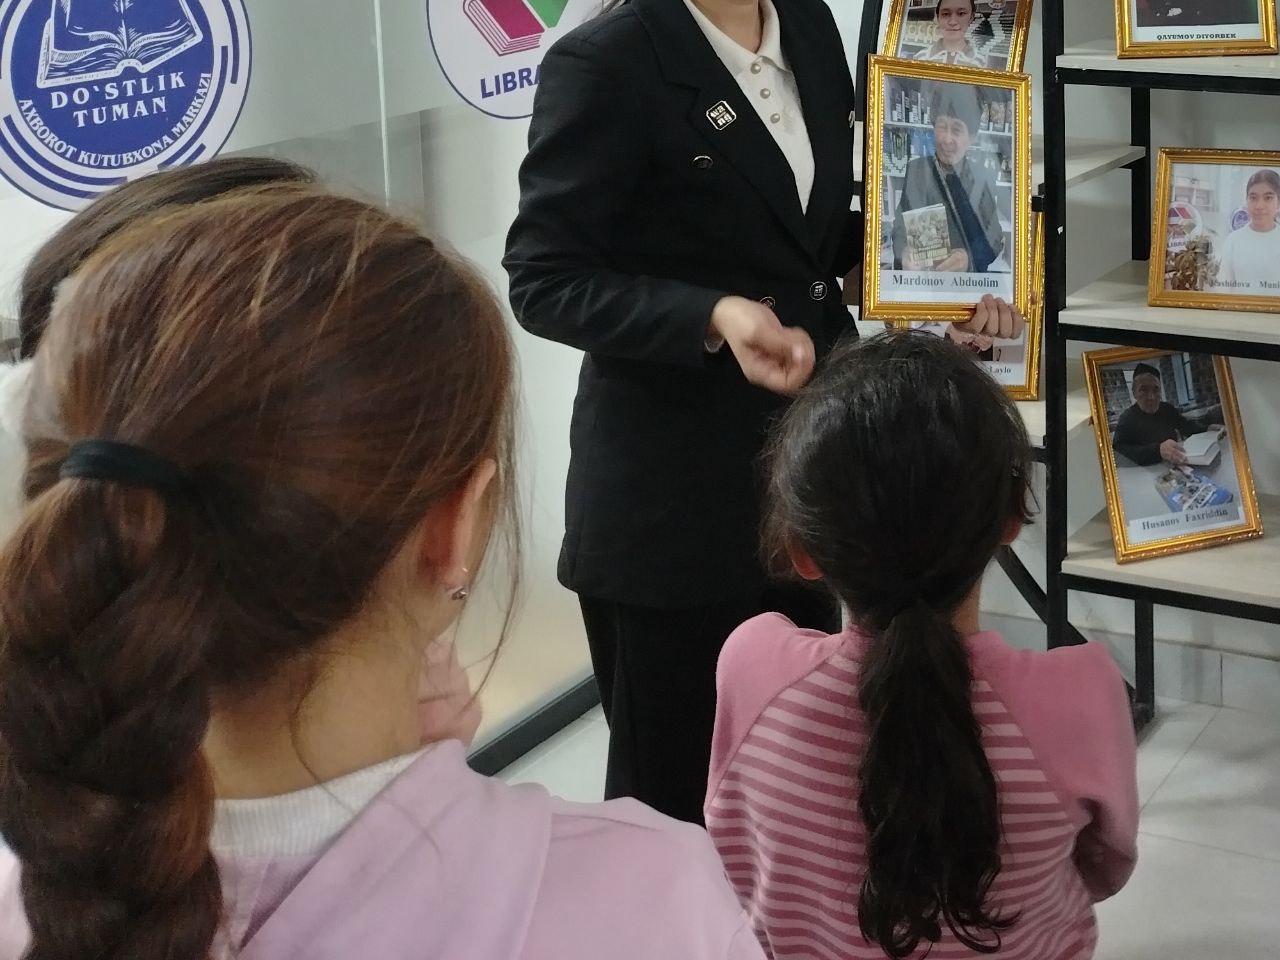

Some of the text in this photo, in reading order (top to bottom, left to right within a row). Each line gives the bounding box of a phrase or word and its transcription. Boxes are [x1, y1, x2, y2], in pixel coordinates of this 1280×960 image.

[18, 72, 212, 167] AXBOROT KUTUBXONA MARKAZI
[73, 96, 167, 128] TUMAN
[892, 274, 999, 288] Mardonov Abduolim
